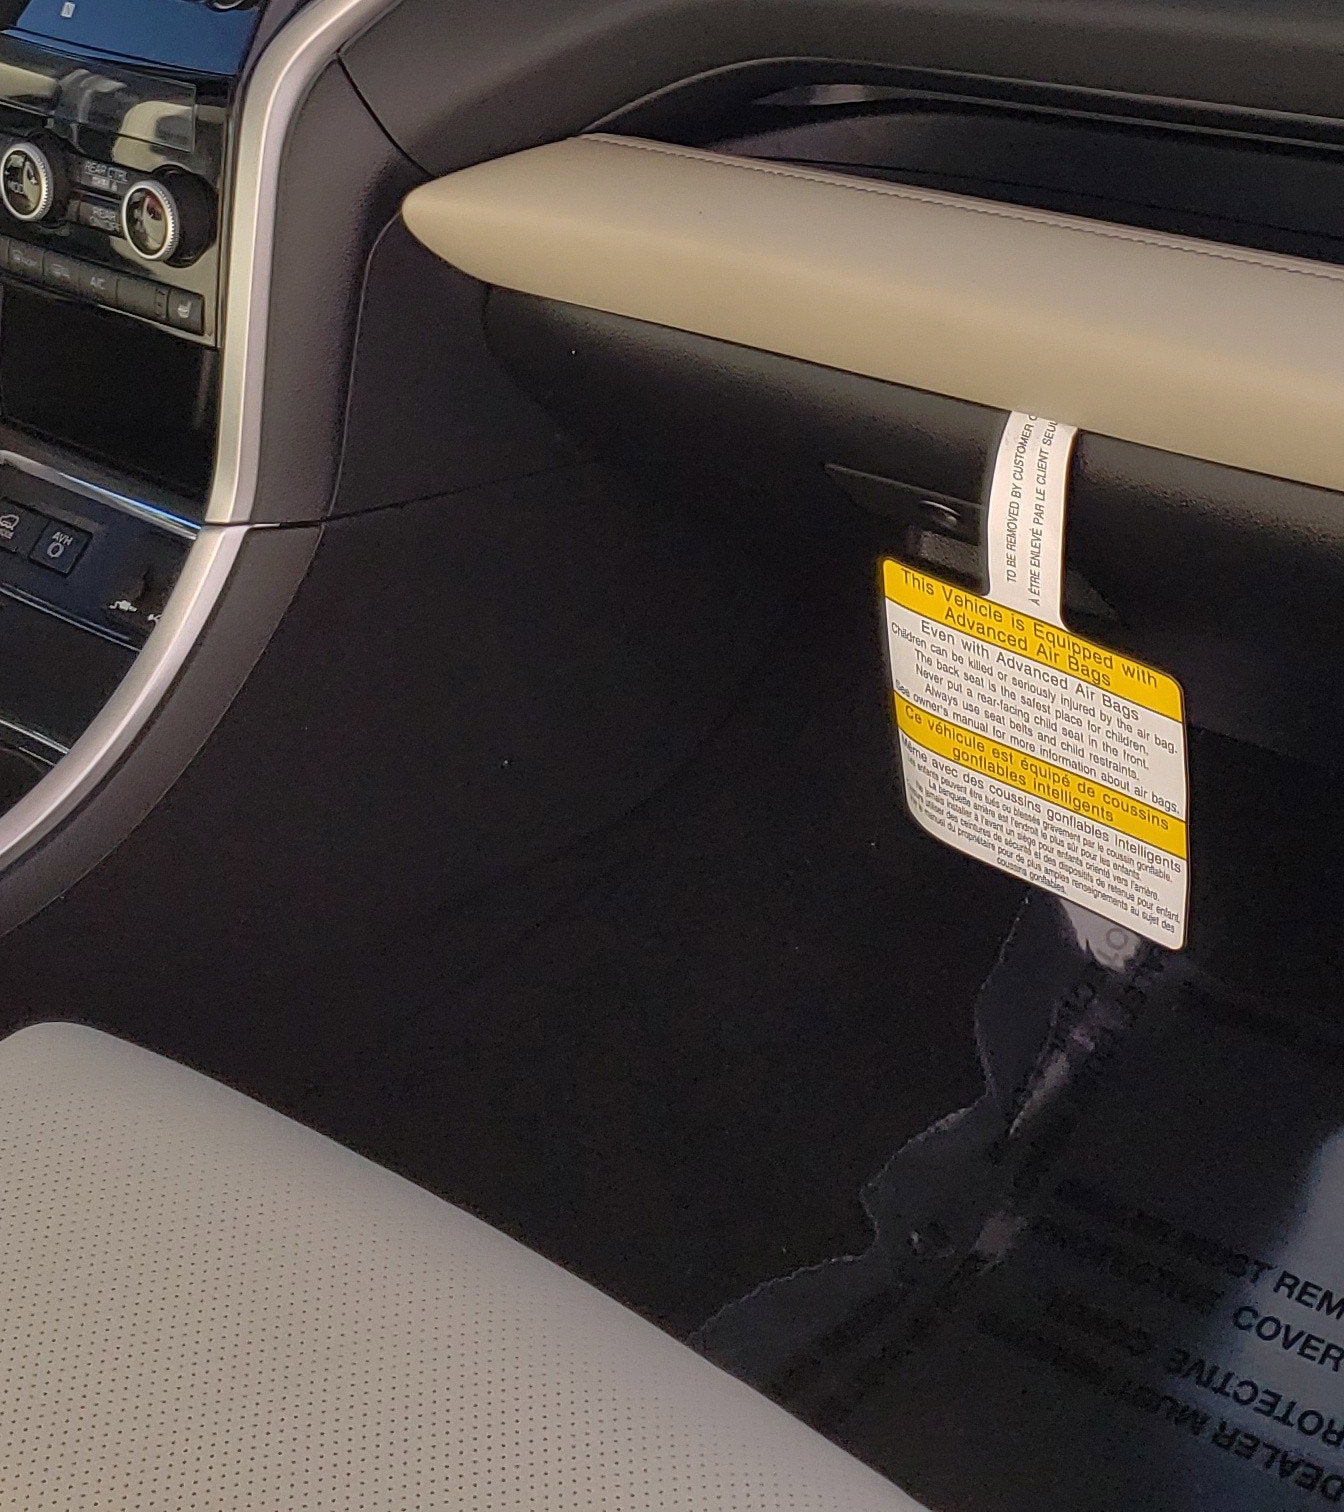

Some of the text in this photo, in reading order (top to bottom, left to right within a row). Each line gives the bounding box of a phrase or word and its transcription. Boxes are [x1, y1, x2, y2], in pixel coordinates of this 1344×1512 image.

[1011, 483, 1023, 499] BY
[1013, 423, 1035, 482] CUSTOMER
[1036, 448, 1050, 486] CLIENT
[1006, 500, 1021, 552] REMOVED
[1033, 503, 1045, 526] PAR
[1037, 488, 1046, 505] LE
[52, 531, 74, 546] AVH
[1006, 570, 1017, 583] TO
[1007, 553, 1017, 570] BE
[901, 567, 1157, 688] This Vehicle is Equipped with
[944, 606, 1110, 688] Advanced Air Bags
[914, 647, 1149, 756] The back seat is the safest place for children.
[920, 619, 1139, 721] Even with Advanced Air Bags
[930, 643, 948, 658] can
[951, 649, 964, 665] be
[968, 655, 993, 677] killed
[996, 670, 1008, 682] or
[1011, 676, 1056, 704] seriously
[1060, 693, 1095, 718] injured
[1099, 709, 1112, 726] by
[1116, 716, 1133, 733] the
[1136, 728, 1150, 741] air
[1154, 733, 1178, 754] bag.
[913, 693, 949, 717] owner's
[952, 710, 988, 733] manual
[992, 724, 1006, 740] for
[1009, 734, 1035, 753] more
[1039, 744, 1096, 778] information
[1100, 771, 1130, 792] about
[1133, 785, 1148, 799] air
[1151, 790, 1180, 816] bags.
[915, 663, 1149, 770] Never put a rear-facing child seat in the front.
[924, 682, 1140, 781] Always use seat belts and child restraints.
[905, 704, 1168, 830] Ce véhicule est équipé de coussins
[952, 747, 1026, 786] gonflables
[1033, 776, 1113, 822] intelligents
[931, 758, 958, 778] avec
[962, 771, 984, 790] des
[988, 780, 1041, 814] coussins
[1046, 805, 1109, 842] gonflables
[1114, 833, 1181, 873] intelligents
